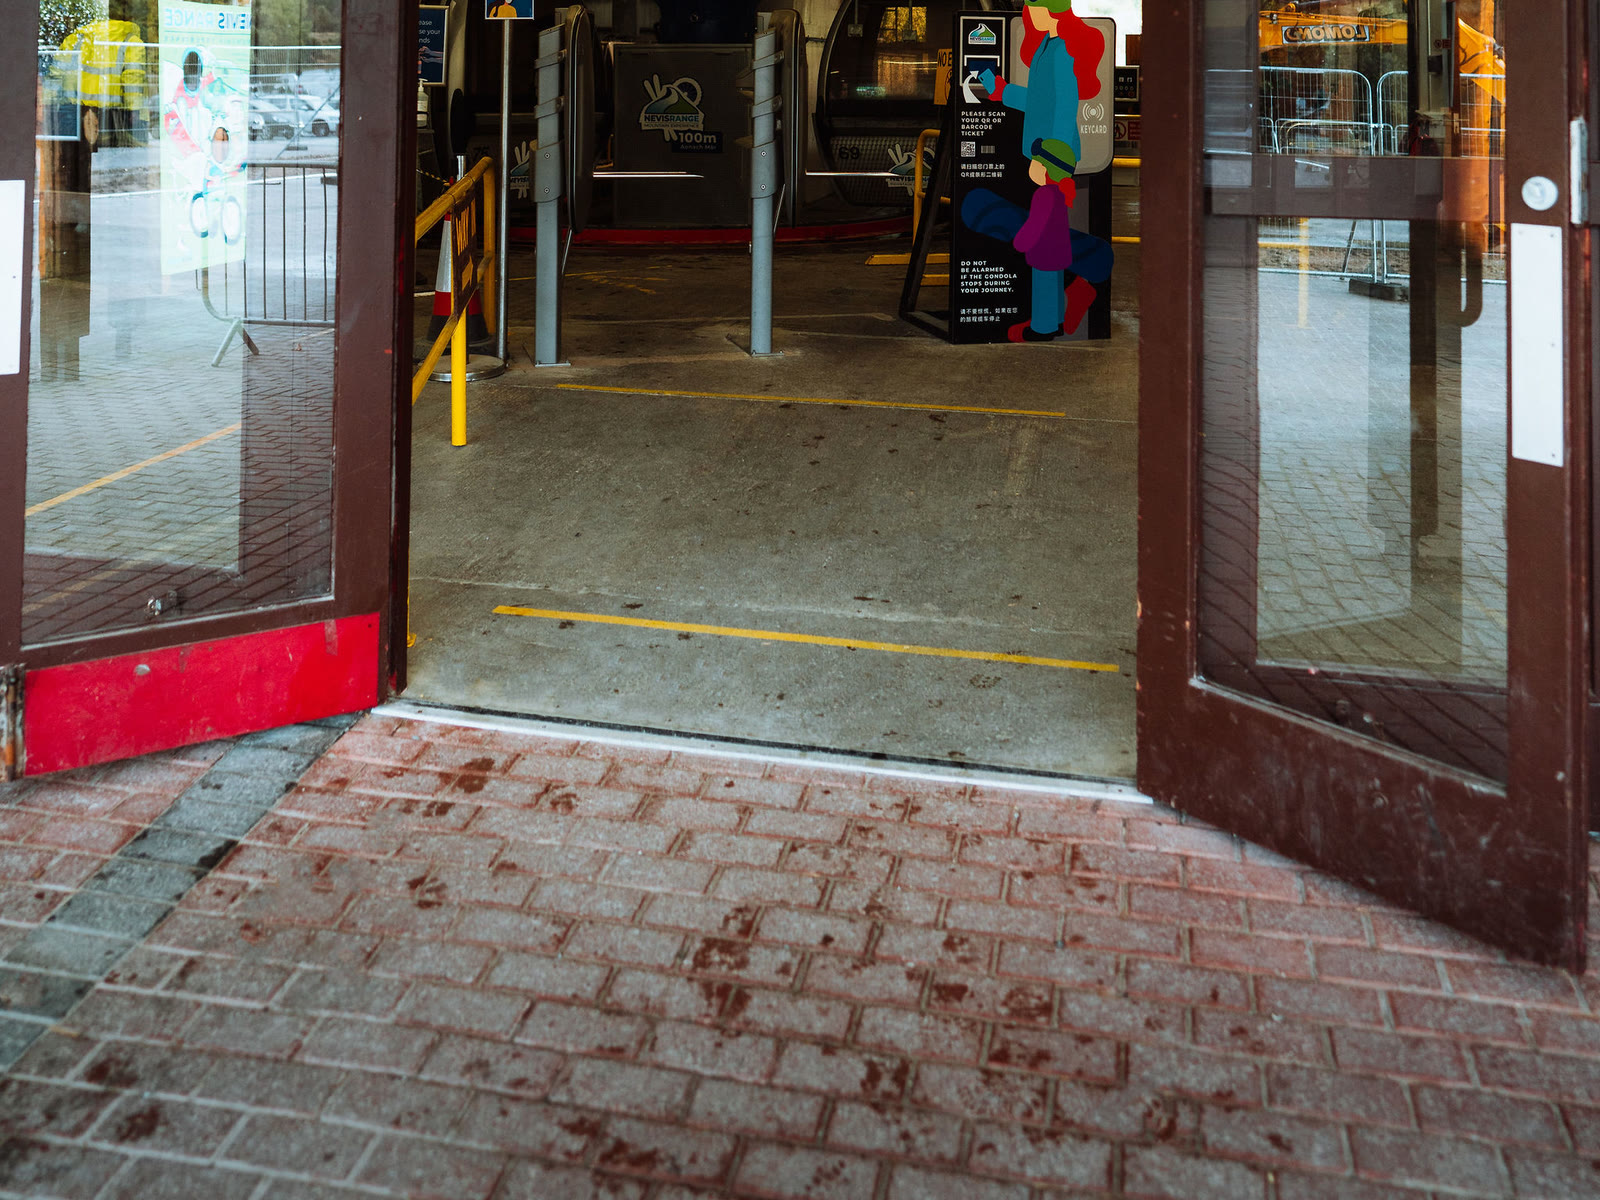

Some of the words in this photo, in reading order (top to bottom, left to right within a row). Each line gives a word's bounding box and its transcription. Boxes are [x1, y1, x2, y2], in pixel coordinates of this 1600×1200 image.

[938, 51, 947, 67] NO
[1080, 124, 1107, 134] KEYCARD
[678, 132, 717, 143] 100m
[838, 146, 860, 160] 69
